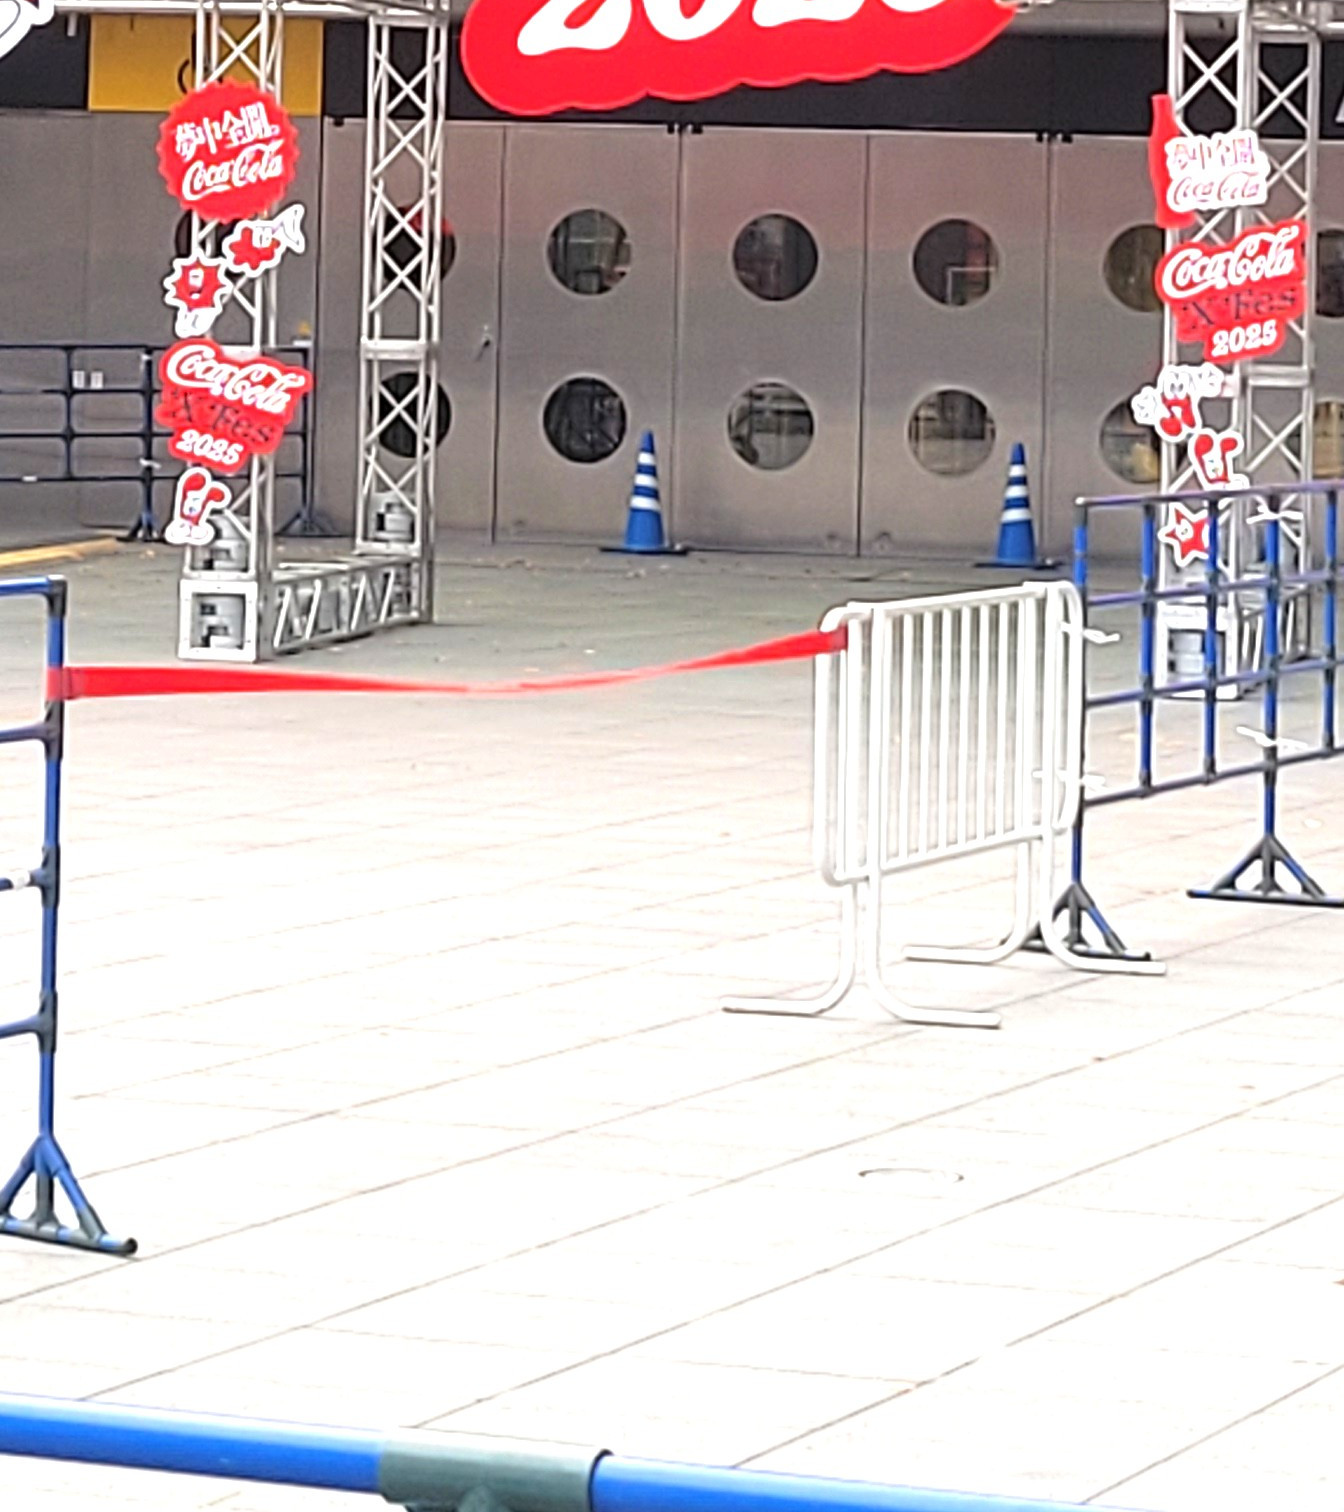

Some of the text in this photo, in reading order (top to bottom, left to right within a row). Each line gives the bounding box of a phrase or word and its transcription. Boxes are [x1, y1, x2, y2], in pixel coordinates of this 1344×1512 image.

[181, 140, 285, 201] Coca-Cola
[1161, 225, 1299, 299] Coca-Cola
[1211, 319, 1278, 357] 2025
[166, 344, 306, 414] Coca-Cola
[175, 429, 244, 465] 2025
